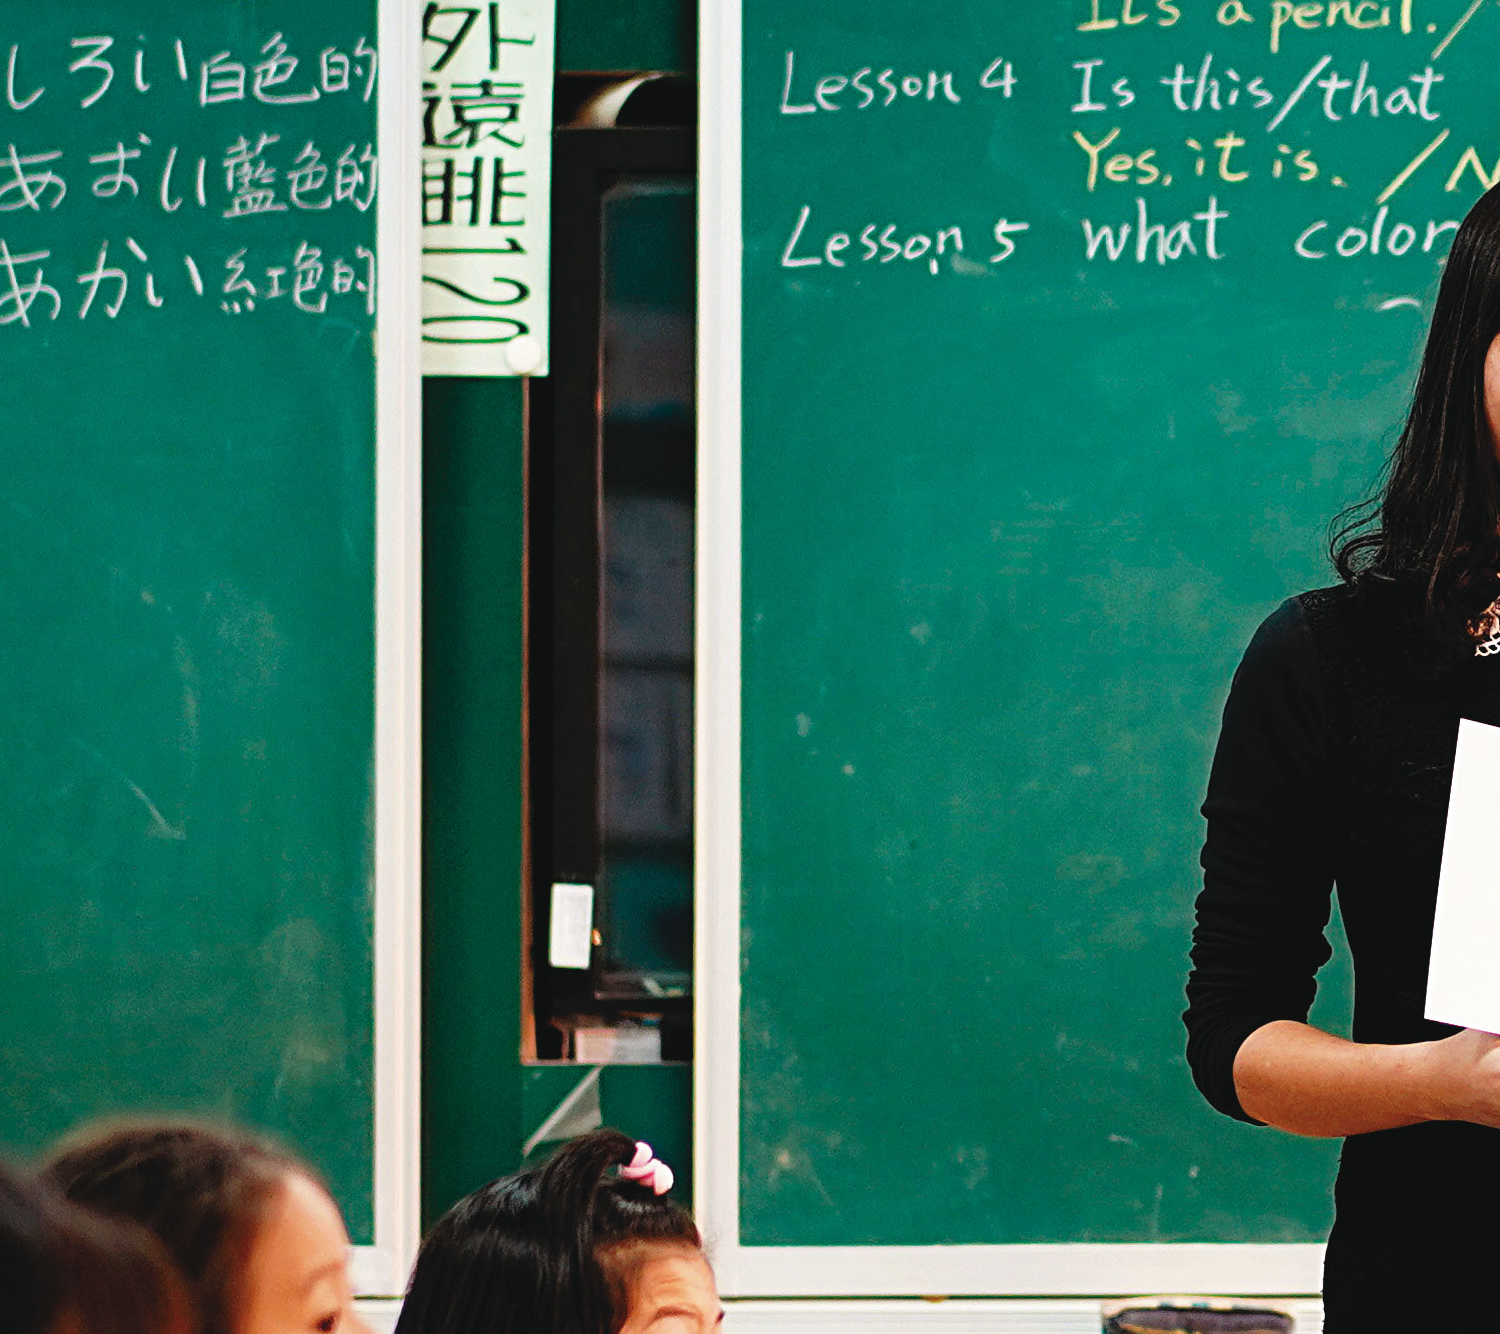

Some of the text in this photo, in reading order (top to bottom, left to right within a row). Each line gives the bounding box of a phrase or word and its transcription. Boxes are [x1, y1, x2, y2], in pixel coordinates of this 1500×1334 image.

[779, 51, 962, 115] Lesson
[979, 56, 1018, 98] 4
[1071, 58, 1136, 113] Is
[1186, 130, 1250, 182] it
[989, 216, 1030, 263] 5
